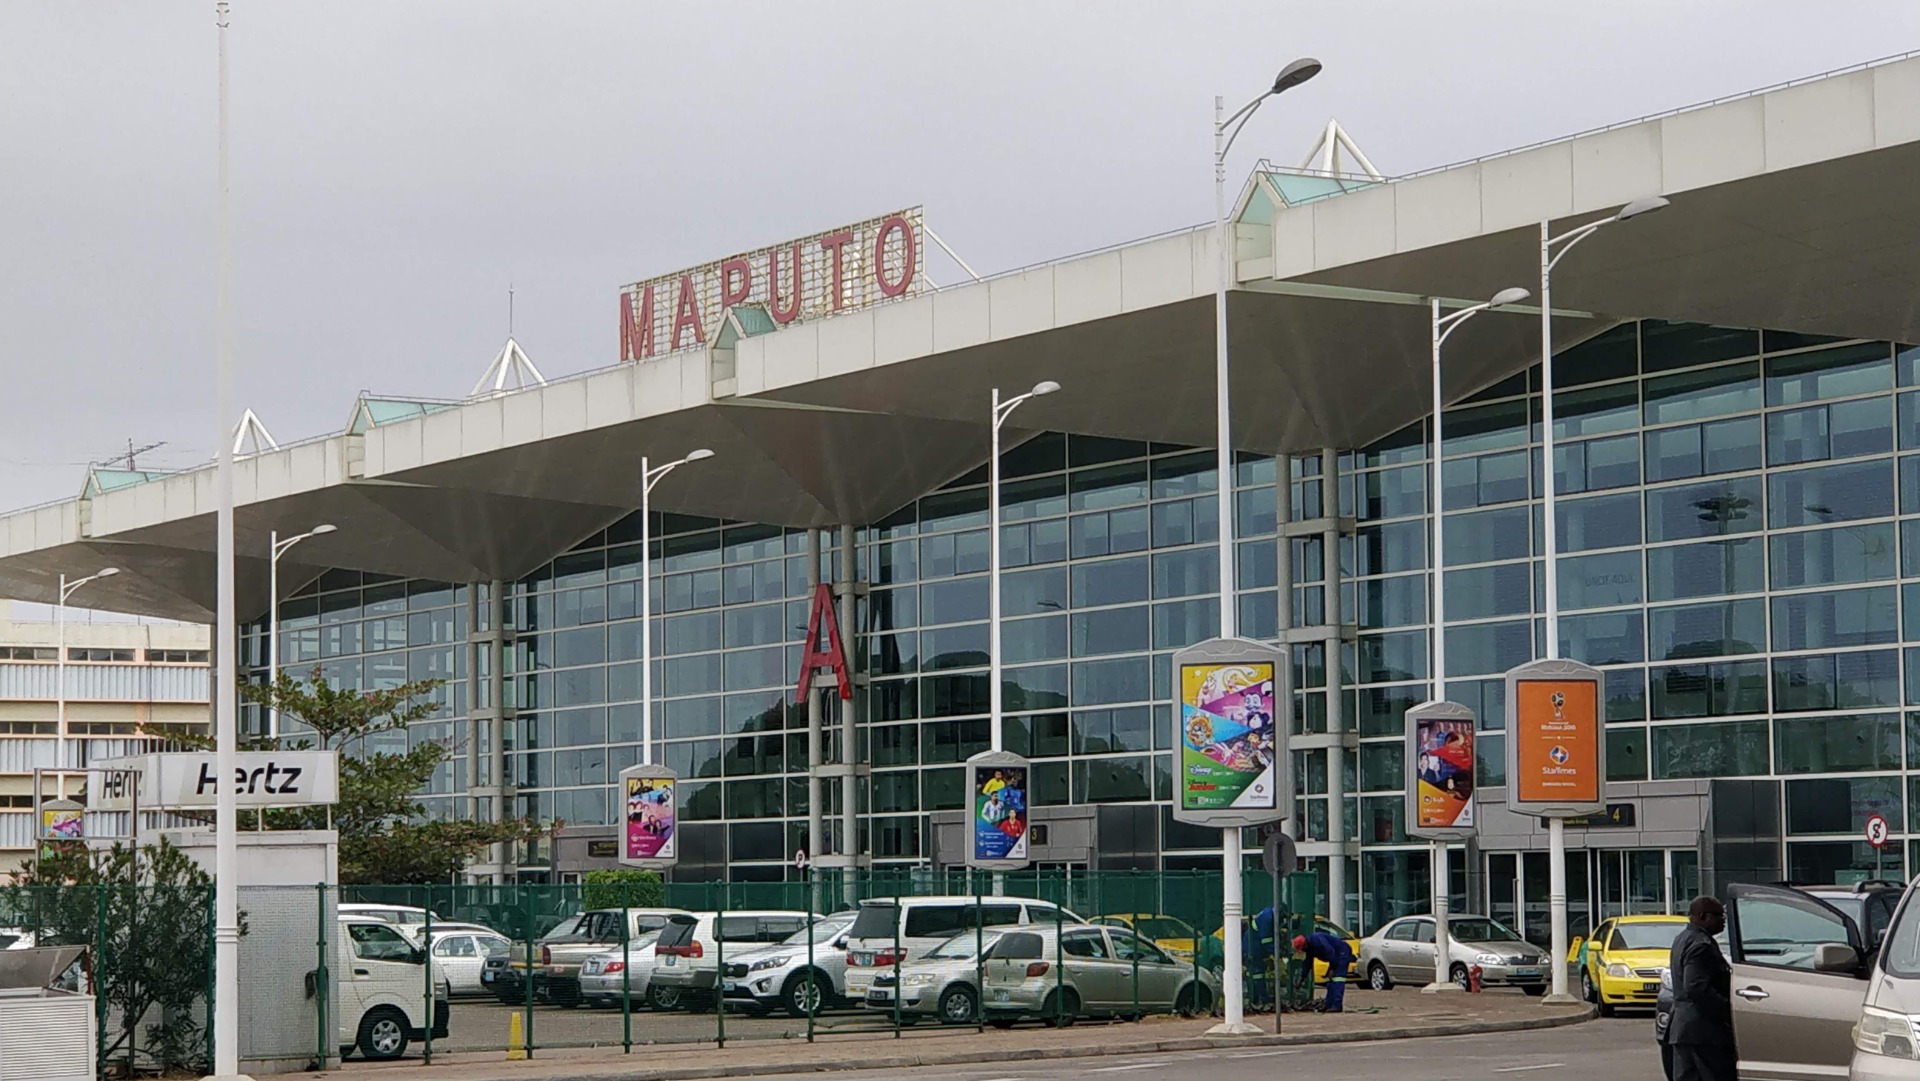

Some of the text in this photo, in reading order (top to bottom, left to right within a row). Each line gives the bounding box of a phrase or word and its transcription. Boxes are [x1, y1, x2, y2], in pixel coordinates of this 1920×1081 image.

[619, 216, 915, 361] MAPUTO
[796, 583, 852, 704] A
[196, 762, 302, 794] Hertz
[1612, 807, 1620, 822] 4
[1031, 828, 1038, 840] 3
